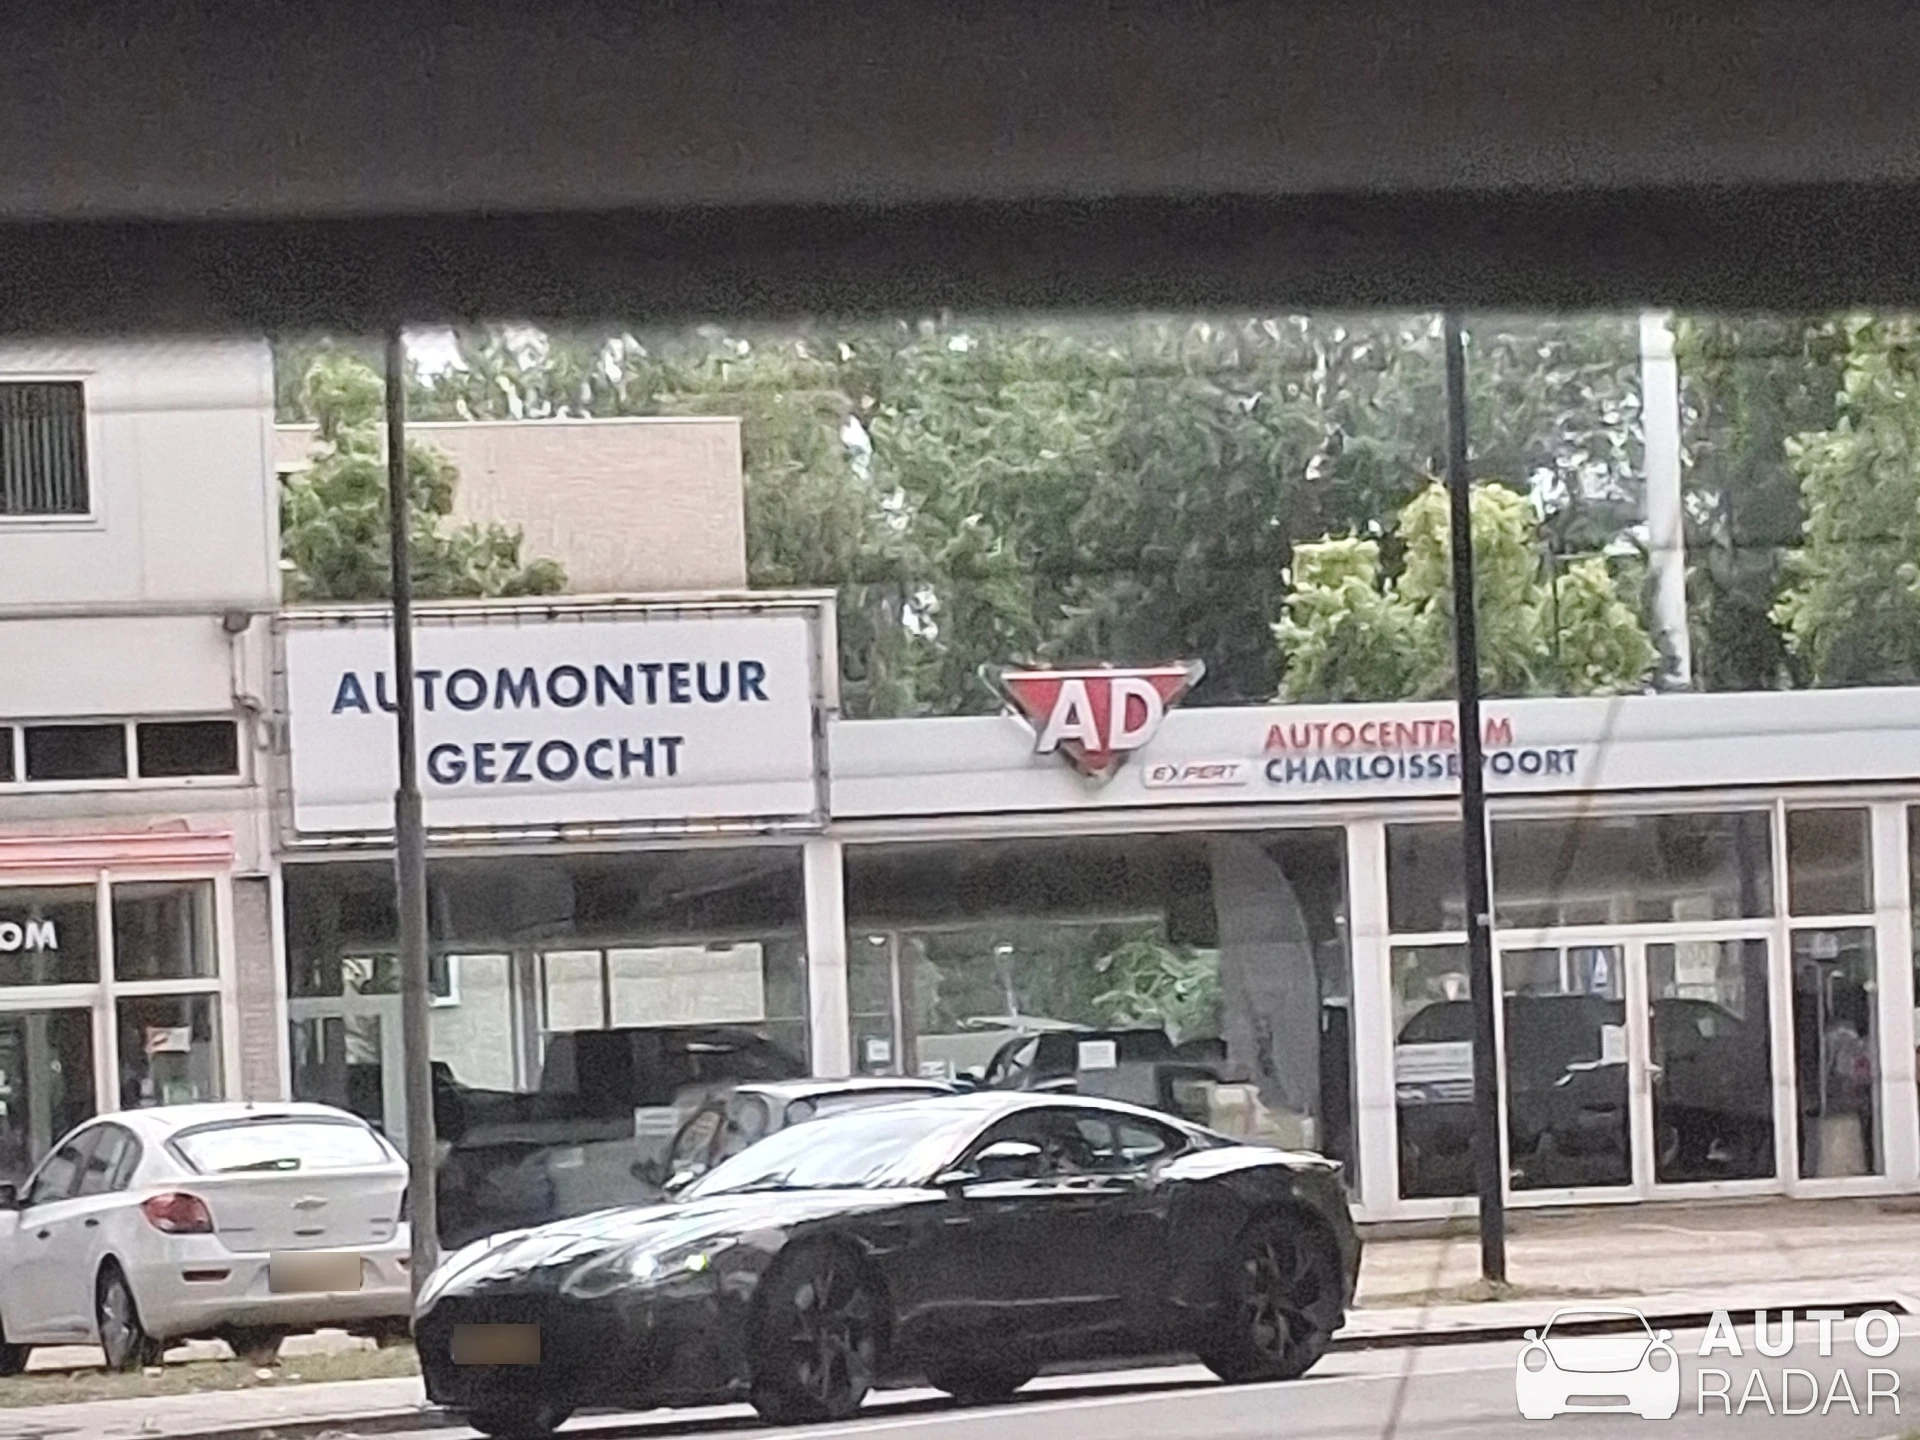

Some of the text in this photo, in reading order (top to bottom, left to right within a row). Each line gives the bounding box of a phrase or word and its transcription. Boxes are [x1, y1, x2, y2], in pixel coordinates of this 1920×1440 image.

[331, 660, 770, 715] AUTOMONTEUR
[1036, 677, 1164, 754] AD
[1264, 717, 1513, 751] AUTOCENTRM
[427, 736, 685, 785] GEZOCHT
[1265, 748, 1579, 784] CHARLOISSEOORT
